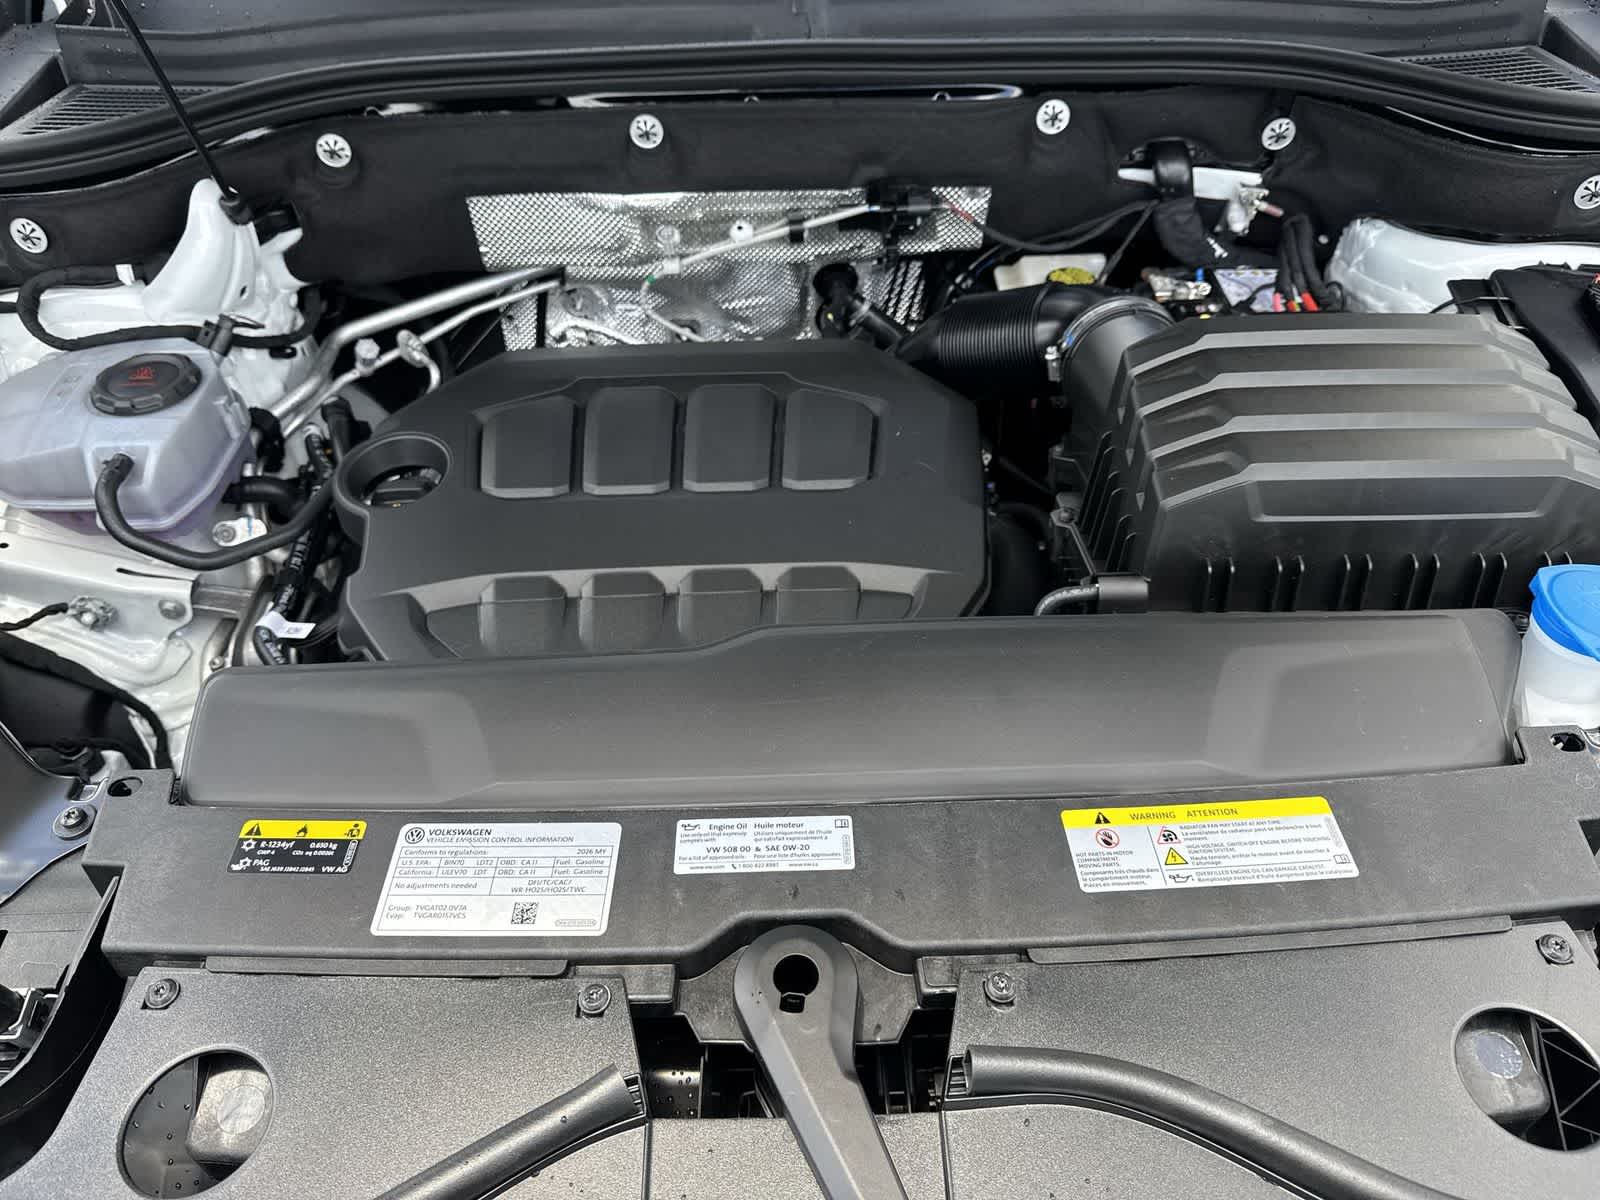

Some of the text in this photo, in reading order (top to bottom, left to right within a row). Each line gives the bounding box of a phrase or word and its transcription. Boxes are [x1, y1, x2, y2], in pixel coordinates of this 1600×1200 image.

[1130, 808, 1238, 820] WARNING ATTENTION
[736, 822, 747, 830] Oil
[754, 821, 774, 829] Huile
[428, 828, 492, 836] VOLKSWAGEN
[260, 840, 295, 850] R-1234yf
[330, 841, 338, 850] kg
[406, 882, 449, 890] adjustments
